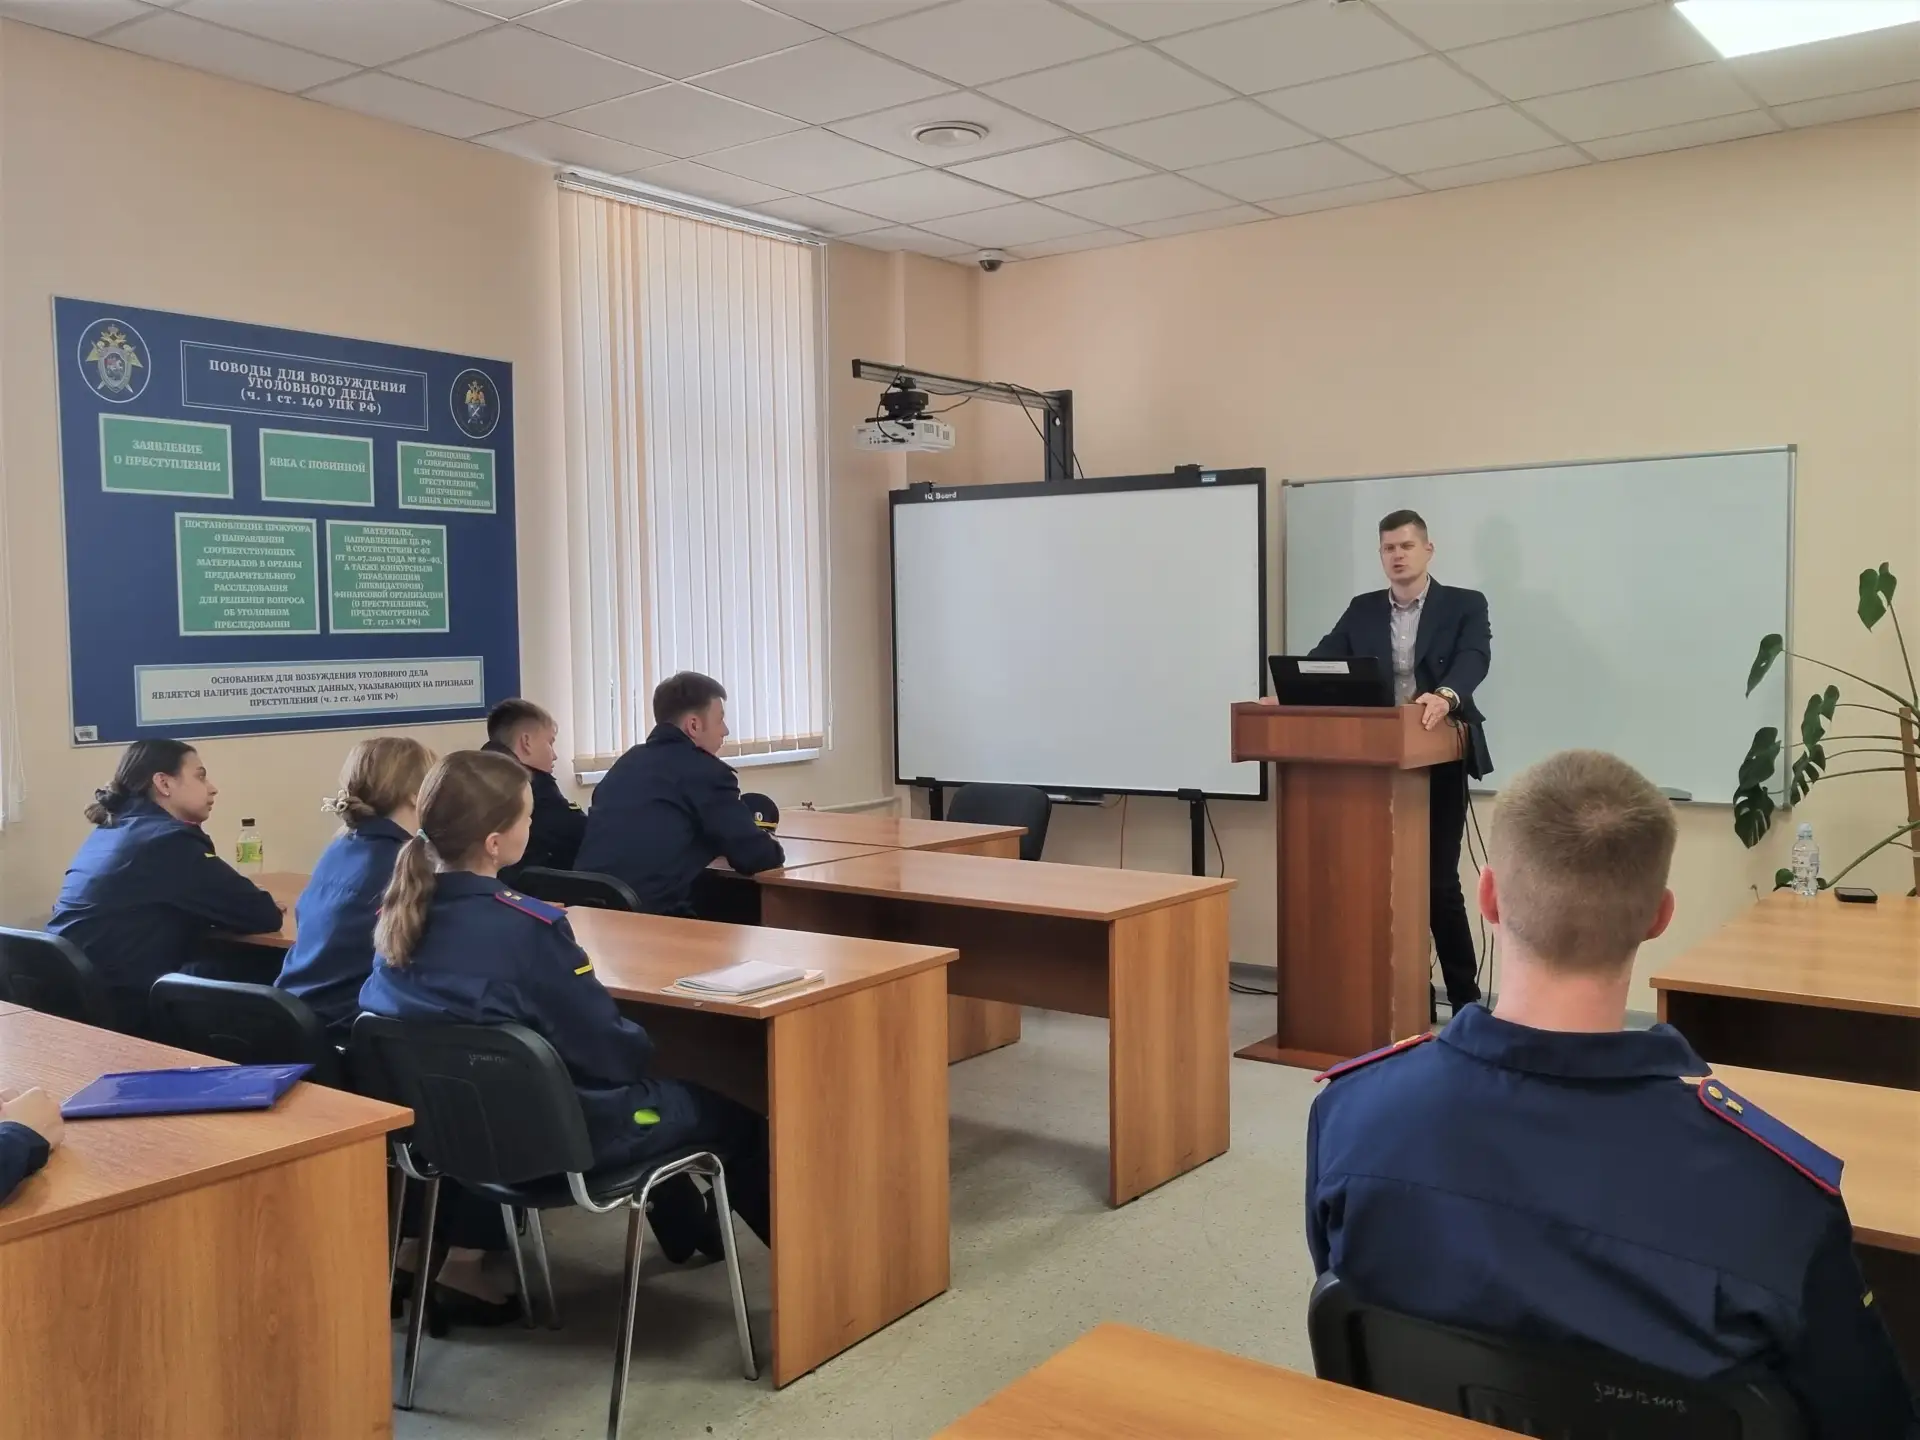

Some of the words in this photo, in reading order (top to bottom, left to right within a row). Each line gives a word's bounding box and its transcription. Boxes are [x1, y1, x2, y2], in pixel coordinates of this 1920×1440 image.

[209, 360, 272, 377] ПОВОДЫ
[277, 368, 305, 382] ДЛЯ
[311, 373, 407, 394] ВОЗБУЖДЕНИЯ
[248, 377, 336, 397] УГОЛОВНОГО
[341, 388, 375, 402] ДЕЛА
[240, 388, 260, 401] (ч.
[267, 393, 272, 402] 1
[277, 395, 296, 405] ст.
[302, 397, 323, 409] 140
[328, 400, 355, 412] УПК
[359, 403, 382, 415] РФ)
[132, 440, 204, 455] ЗАЯВЛЕНИЕ
[426, 450, 472, 460] СООБЩЕНИЕ
[114, 455, 122, 464] О
[125, 455, 221, 472] ПРЕСТУПЛЕНИИ
[270, 457, 298, 468] ЯВКА
[300, 460, 307, 468] С
[309, 460, 366, 473] ПОВИННОЙ
[925, 493, 933, 501] IQ
[936, 492, 957, 500] Board
[184, 520, 263, 531] ПОСТАНОВЛЕНИЕ
[265, 524, 311, 533] ПРОКУРОРА
[363, 527, 414, 537] МАТЕРИАЛЫ,
[215, 534, 221, 542] О
[222, 534, 285, 544] НАПРАВЛЕНИИ
[344, 536, 408, 545] НАПРАВЛЕННЫЕ
[204, 546, 296, 556] СООТВЕТСТВУЮЩИХ
[197, 559, 258, 568] МАТЕРИАЛОВ
[260, 560, 265, 568] В
[268, 560, 302, 569] ОРГАНЫ
[387, 556, 406, 564] ГОДА
[380, 565, 433, 573] КОНКУРСНЫМ
[205, 571, 296, 581] ПРЕДВАРИТЕЛЬНОГО
[358, 573, 421, 581] УПРАВЛЯЮЩИМ
[214, 584, 289, 593] РАССЛЕДОВАНИЯ
[334, 590, 388, 599] ФИНАНСОВОЙ
[390, 592, 444, 600] ОРГАНИЗАЦИИ
[199, 596, 218, 605] ДЛЯ
[220, 596, 265, 604] РЕШЕНИЯ
[352, 600, 361, 608] (О
[224, 609, 235, 617] ОБ
[238, 609, 290, 617] УГОЛОВНОМ
[351, 610, 430, 618] ПРЕДУСМОТРЕННЫХ
[214, 620, 291, 630] ПРЕСЛЕДОВАНИИ
[211, 674, 274, 684] ОСНОВАНИЕМ
[276, 674, 293, 683] ДЛЯ
[296, 672, 357, 681] ВОЗБУЖДЕНИЯ
[358, 670, 407, 679] УГОЛОВНОГО
[409, 670, 428, 678] ДЕЛА
[152, 690, 200, 700] ЯВЛЯЕТСЯ
[204, 688, 248, 697] НАЛИЧИЕ
[250, 685, 316, 697] ДОСТАТОЧНЫХ
[318, 684, 357, 693] ДАННЫХ,
[358, 681, 422, 691] УКАЗЫВАЮЩИХ
[435, 680, 474, 688] ПРИЗНАКИ
[250, 696, 319, 707] ПРЕСТУПЛЕНИЯ
[352, 694, 366, 703] 140
[367, 693, 383, 701] УПК
[384, 692, 399, 701] РФ)
